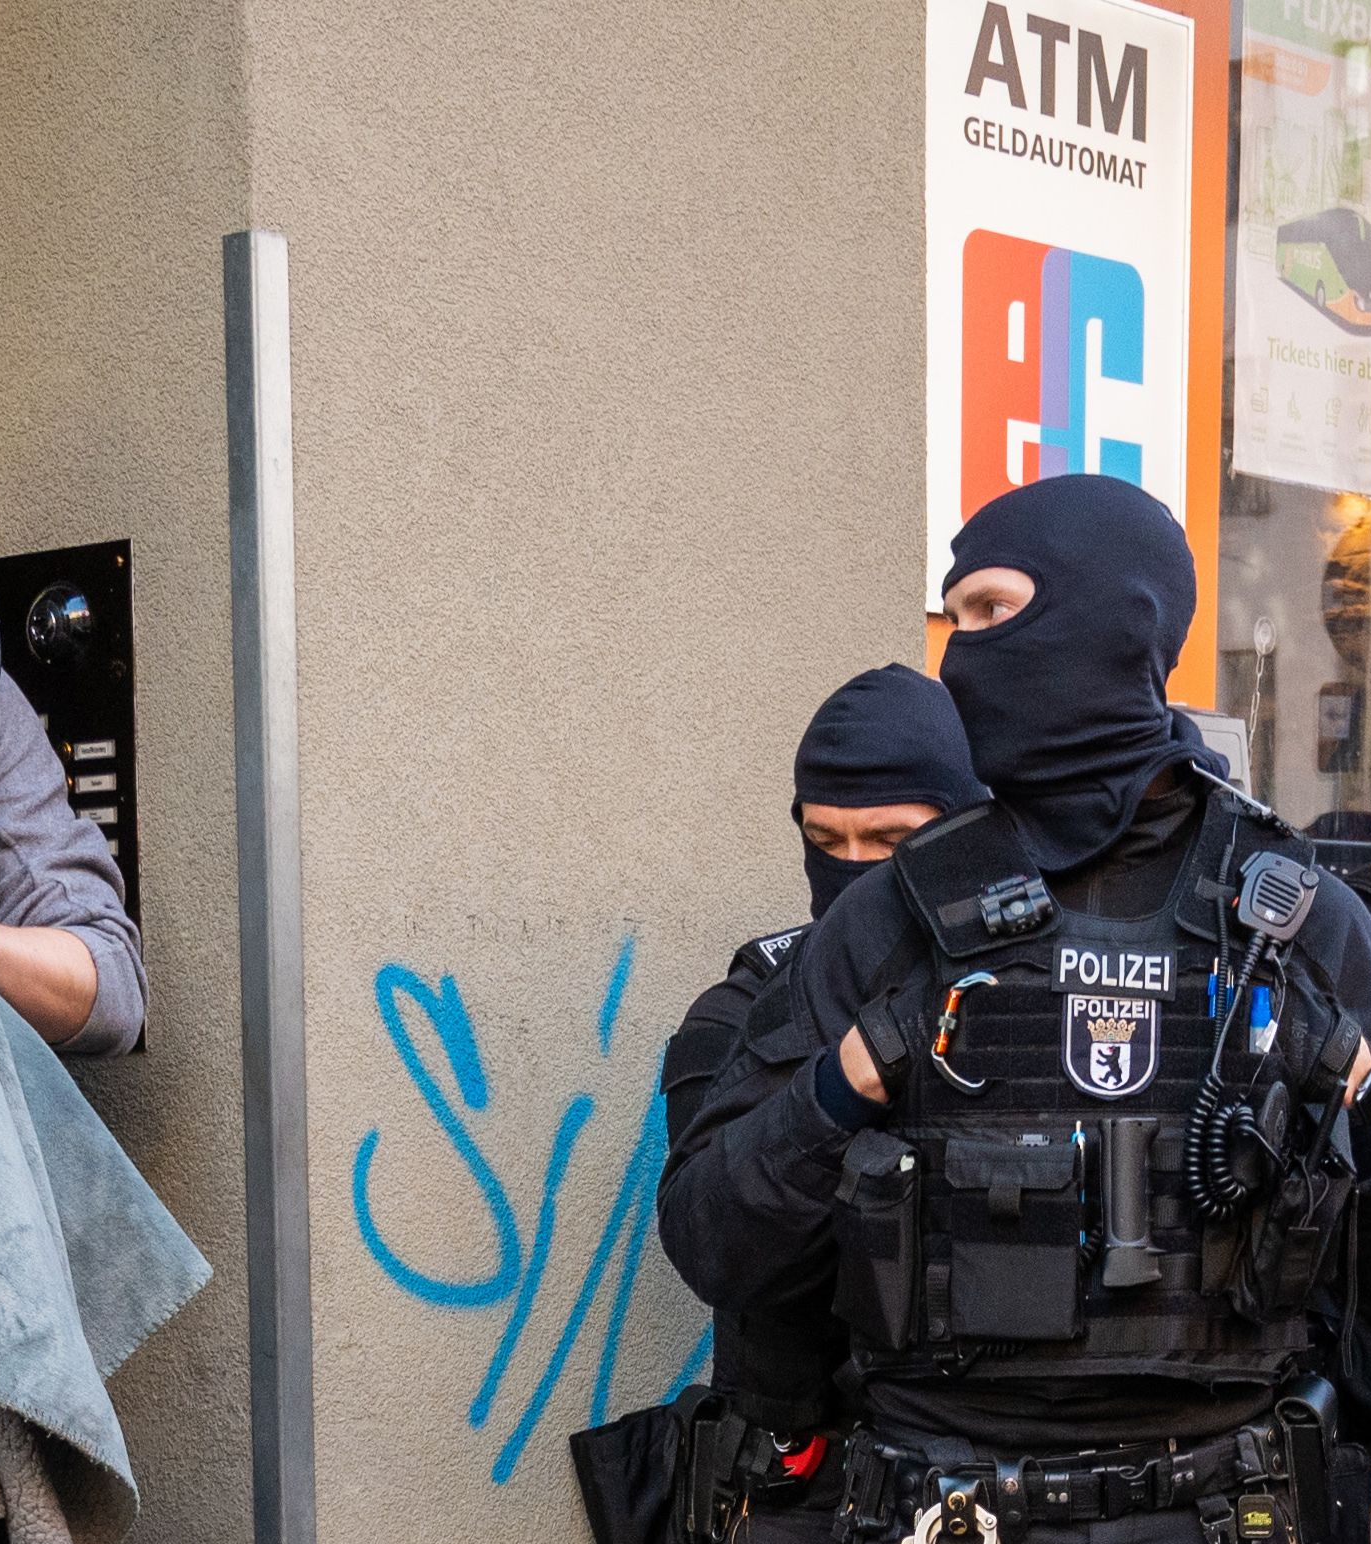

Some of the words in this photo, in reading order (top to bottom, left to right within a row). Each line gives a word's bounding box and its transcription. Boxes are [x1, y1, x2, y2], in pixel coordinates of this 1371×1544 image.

[965, 2, 1147, 144] ATM
[963, 116, 1147, 190] GELDAUTOMAT
[1268, 337, 1320, 369] Tickets
[1325, 350, 1352, 376] hier
[1059, 947, 1170, 992] POLIZEI
[1073, 999, 1150, 1020] POLIZEI
